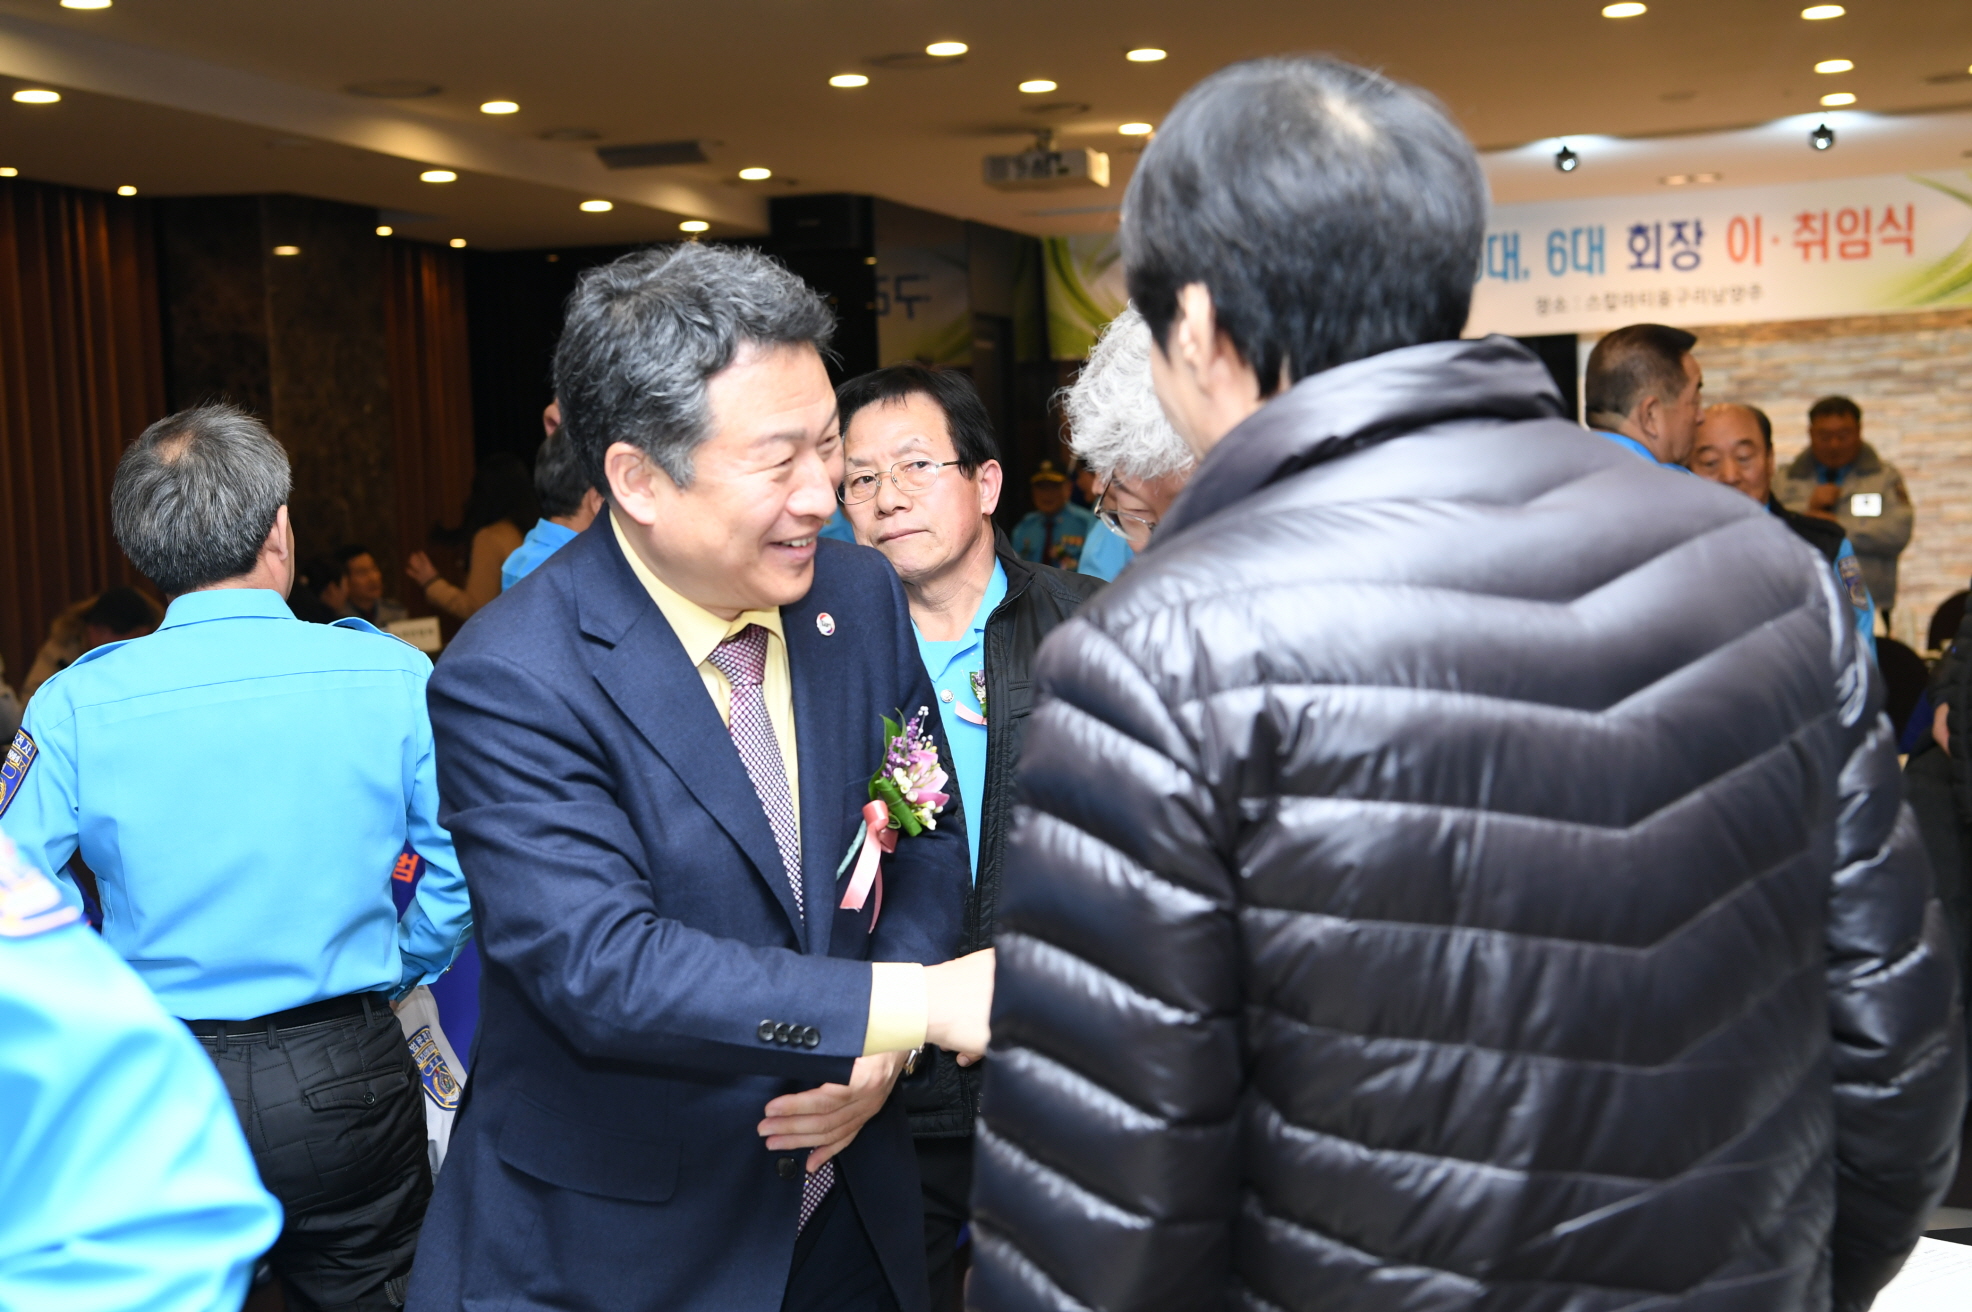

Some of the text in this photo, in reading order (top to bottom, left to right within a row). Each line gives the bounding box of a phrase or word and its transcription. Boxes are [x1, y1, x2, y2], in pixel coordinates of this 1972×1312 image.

[1473, 231, 1530, 284] 대,
[1546, 224, 1606, 277] 6대
[1627, 218, 1704, 272] 회장
